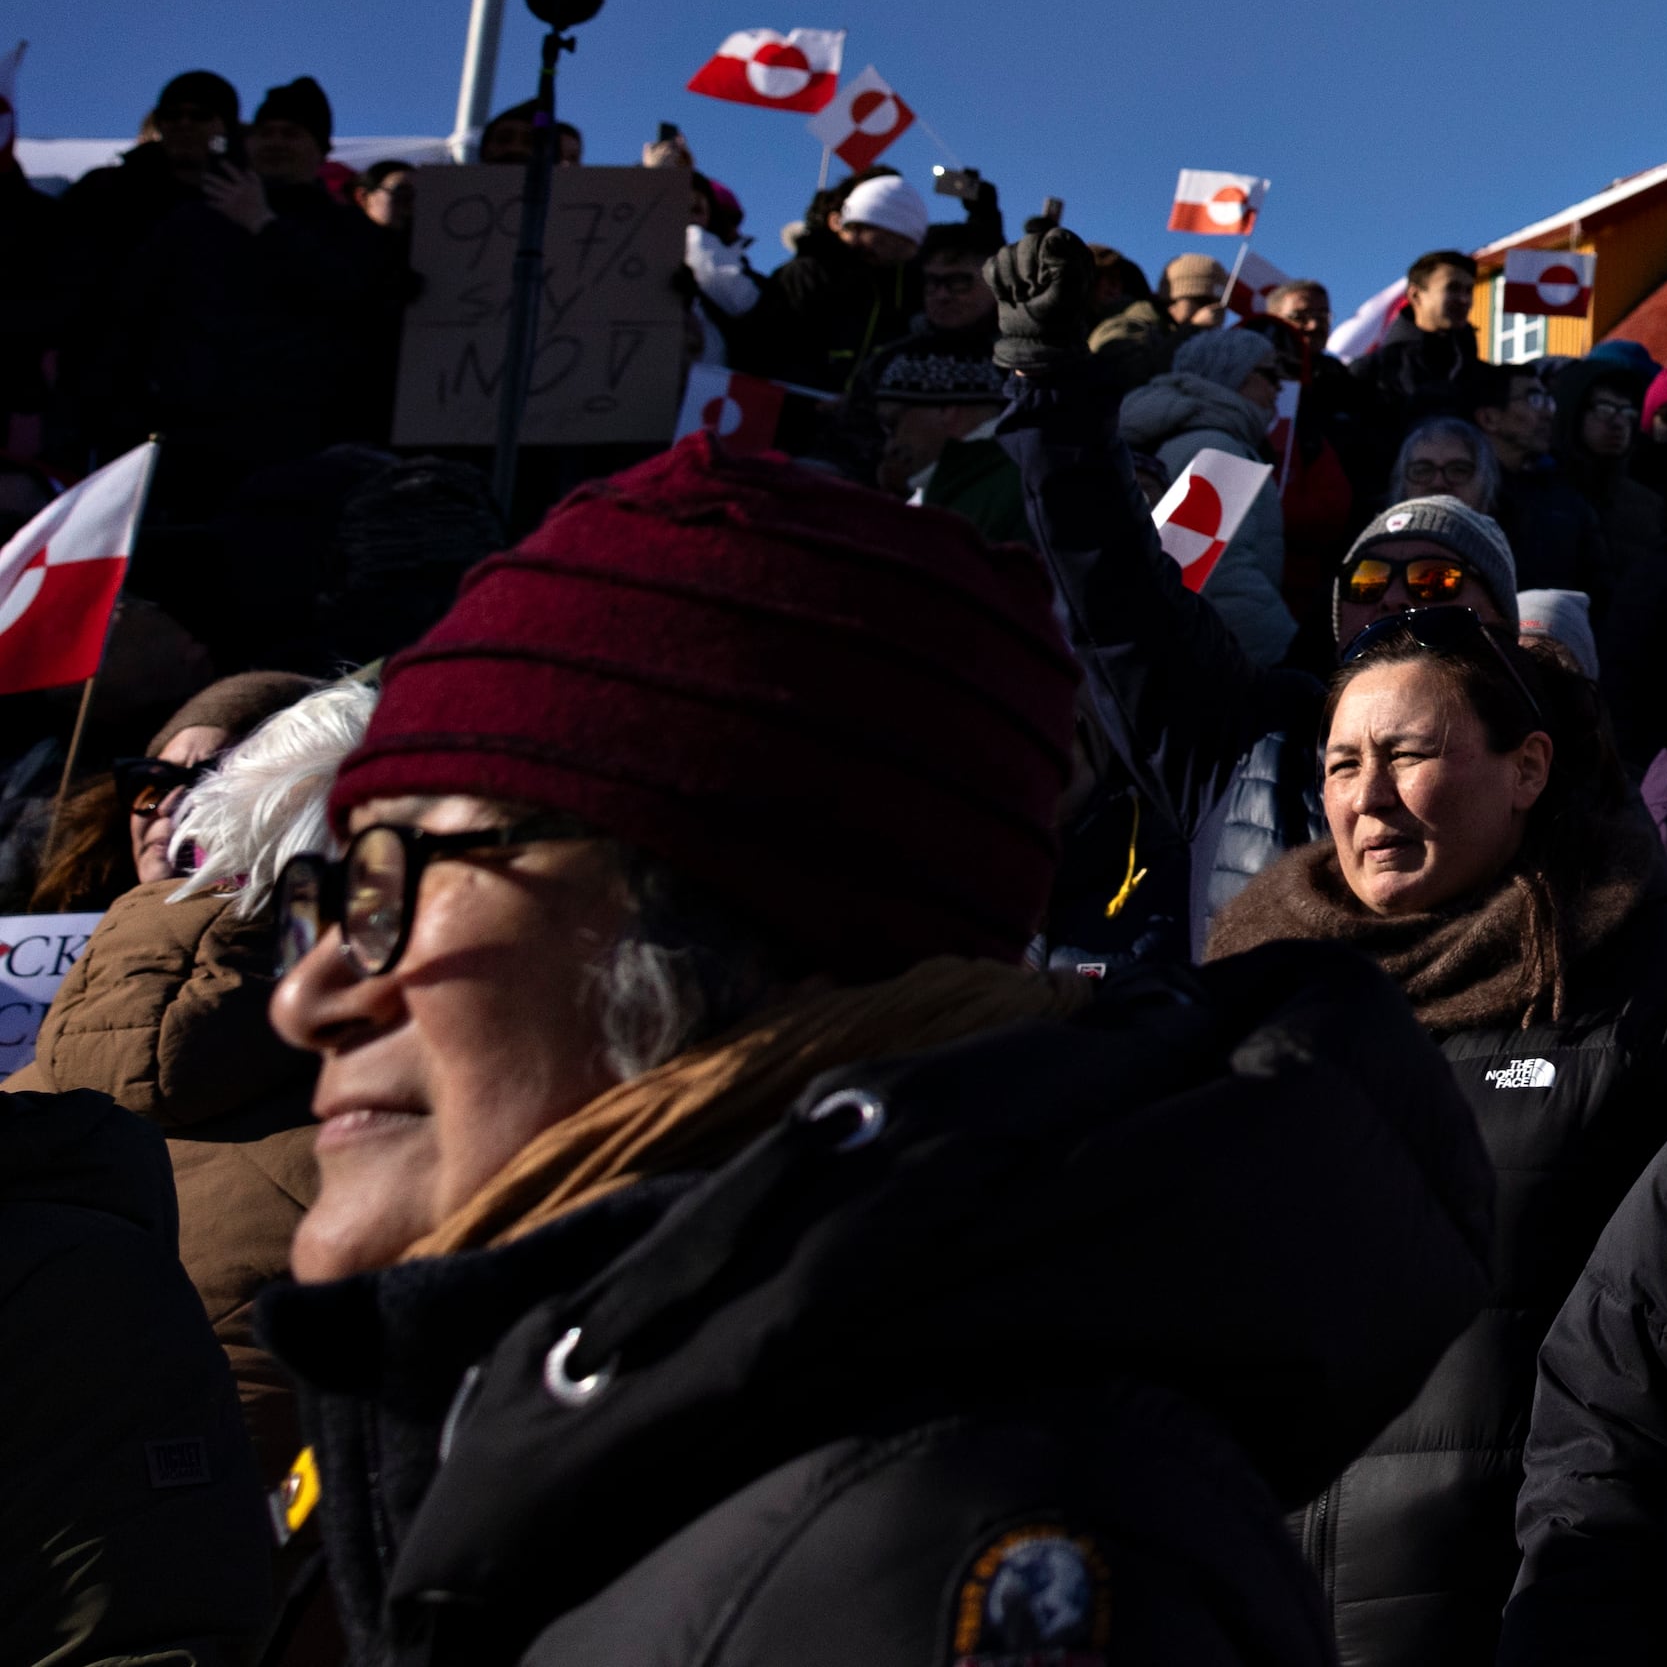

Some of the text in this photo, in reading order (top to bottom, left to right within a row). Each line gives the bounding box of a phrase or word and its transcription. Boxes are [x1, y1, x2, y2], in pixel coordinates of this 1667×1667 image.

[1510, 1059, 1536, 1069] THE
[1485, 1068, 1532, 1081] NORTH
[1495, 1077, 1530, 1089] FACE
